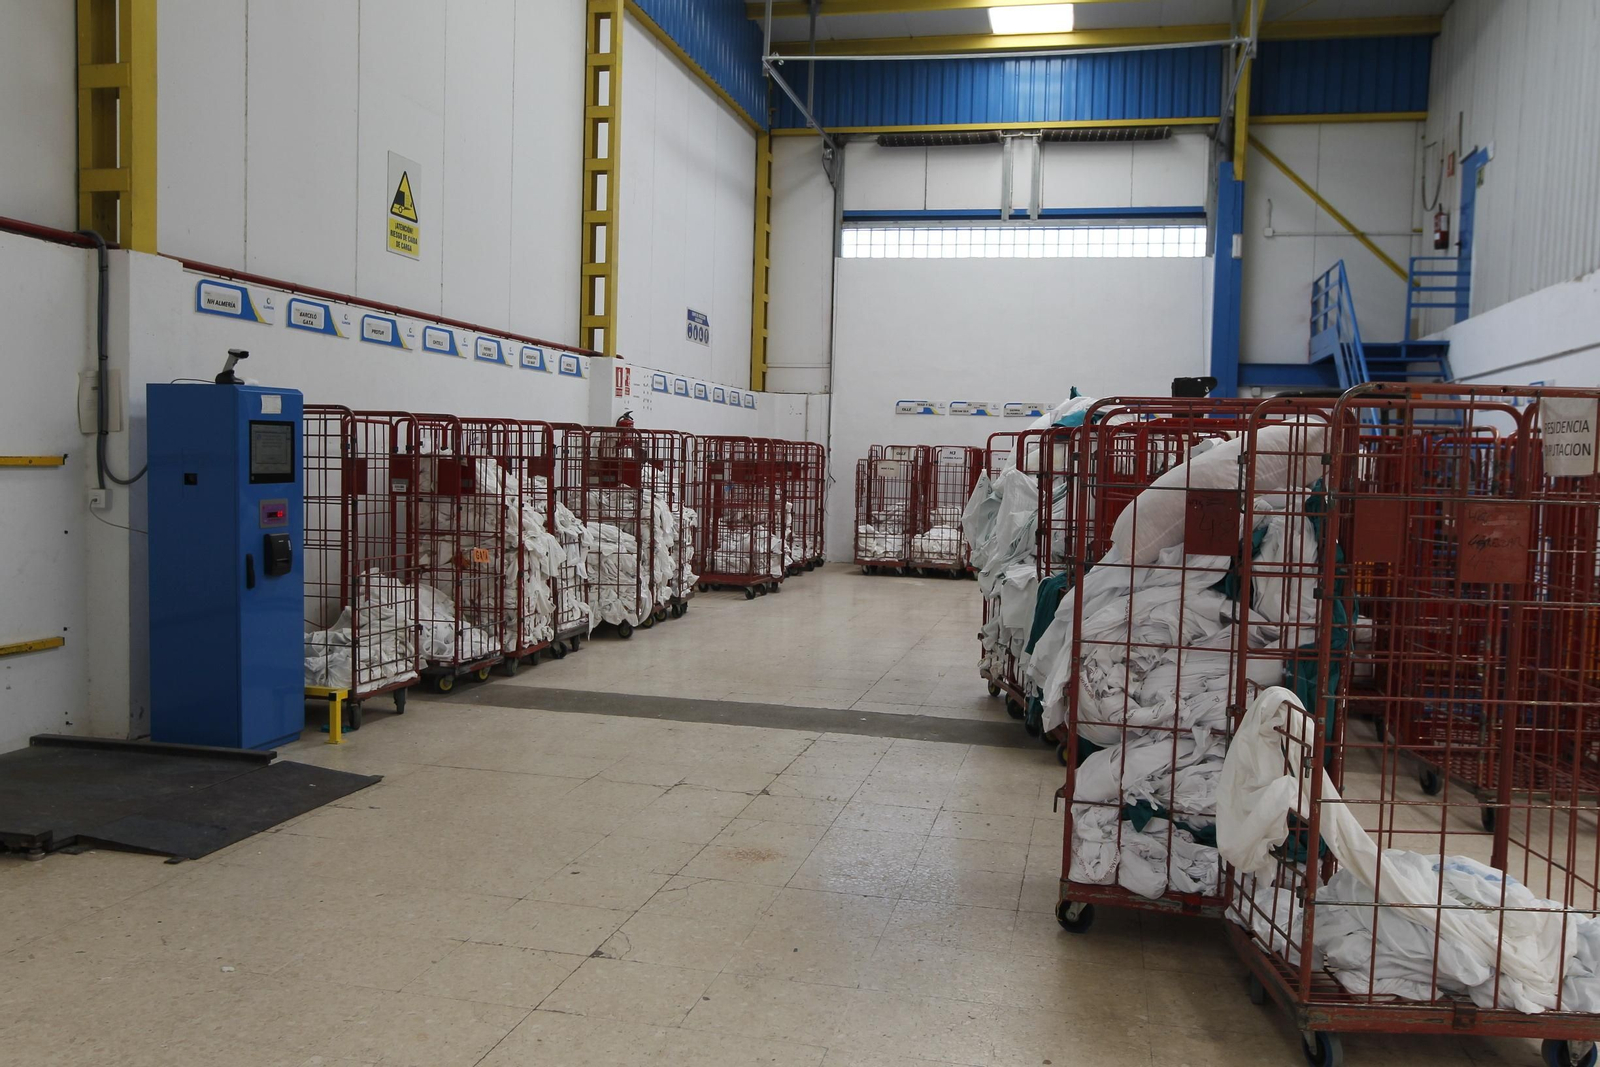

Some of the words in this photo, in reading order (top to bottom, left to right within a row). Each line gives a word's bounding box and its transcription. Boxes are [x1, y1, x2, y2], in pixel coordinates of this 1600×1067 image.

[390, 229, 402, 240] RIESGO
[403, 233, 407, 241] DE
[396, 240, 400, 248] DE
[401, 242, 412, 252] CARGA
[215, 299, 236, 309] ALMERÍA
